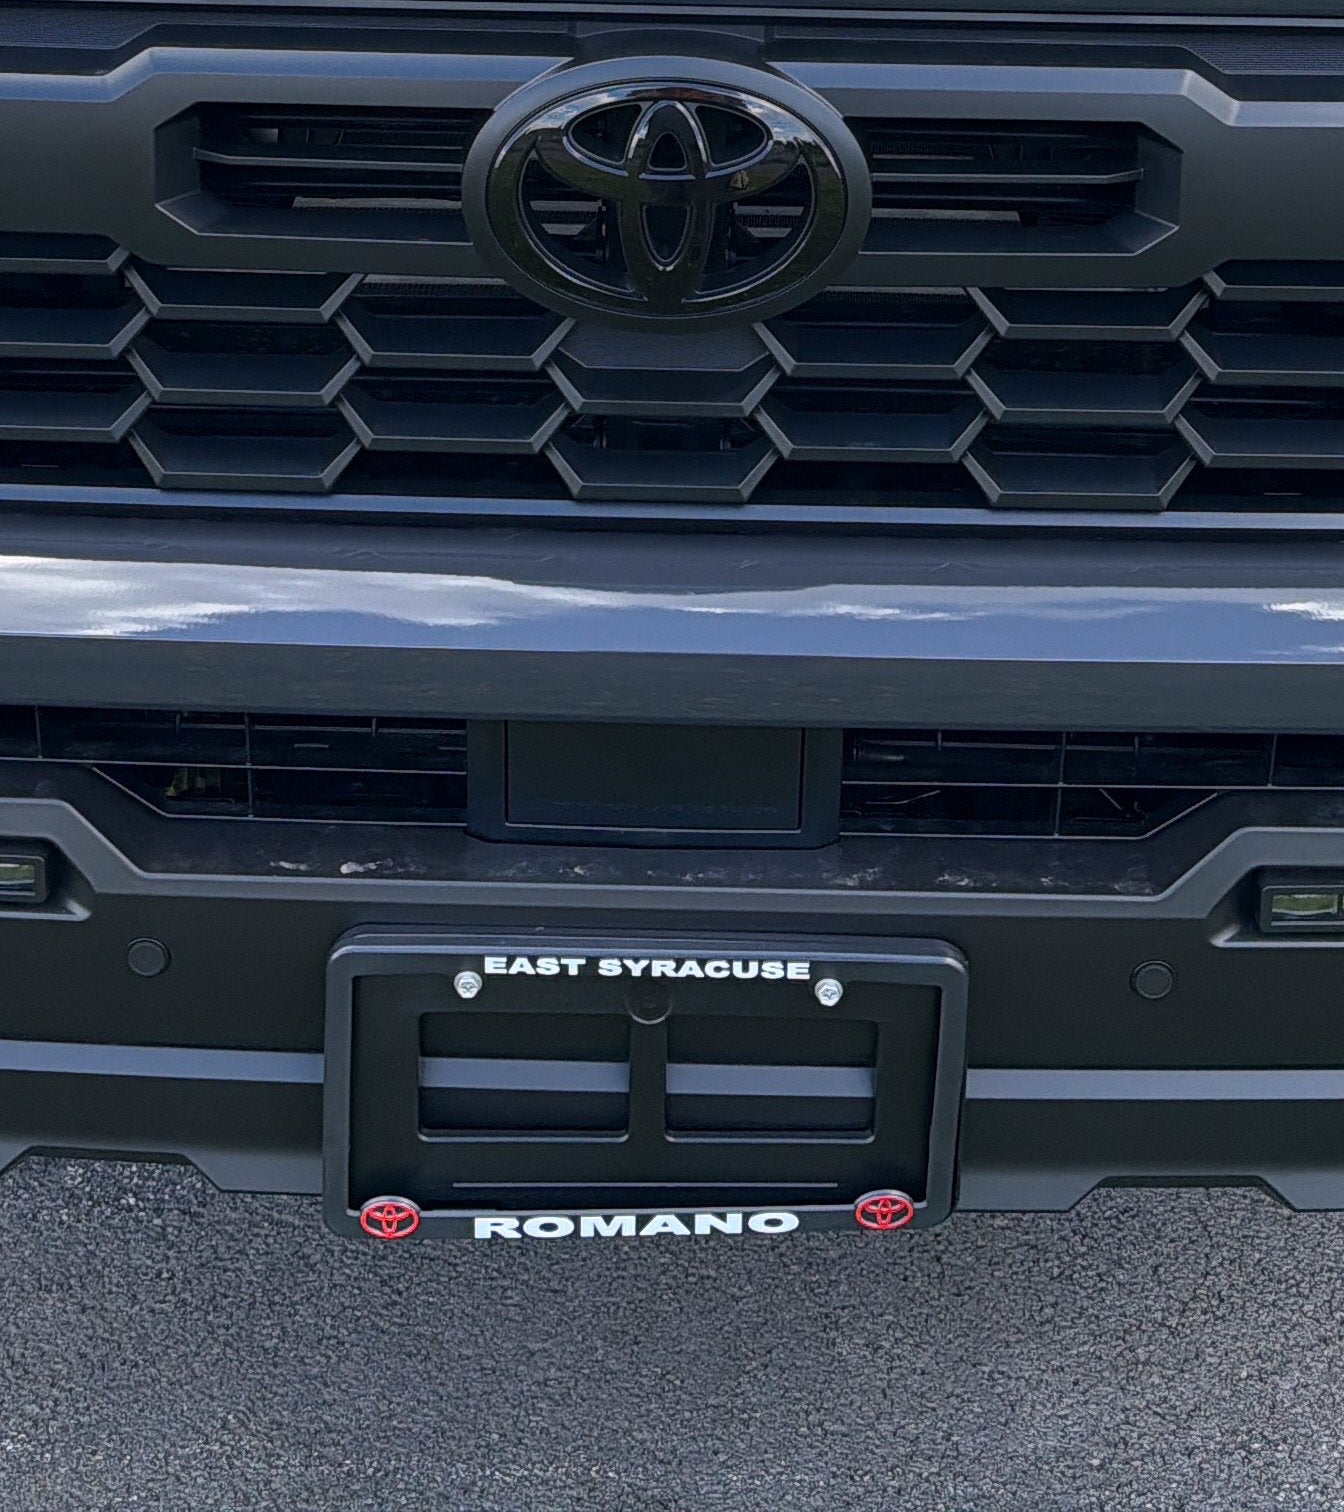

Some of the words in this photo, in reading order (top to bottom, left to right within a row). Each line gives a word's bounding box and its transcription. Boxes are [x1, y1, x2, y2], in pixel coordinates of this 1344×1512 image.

[483, 955, 587, 976] EAST
[597, 957, 811, 980] SYRACUSE
[473, 1211, 800, 1239] ROMANO
